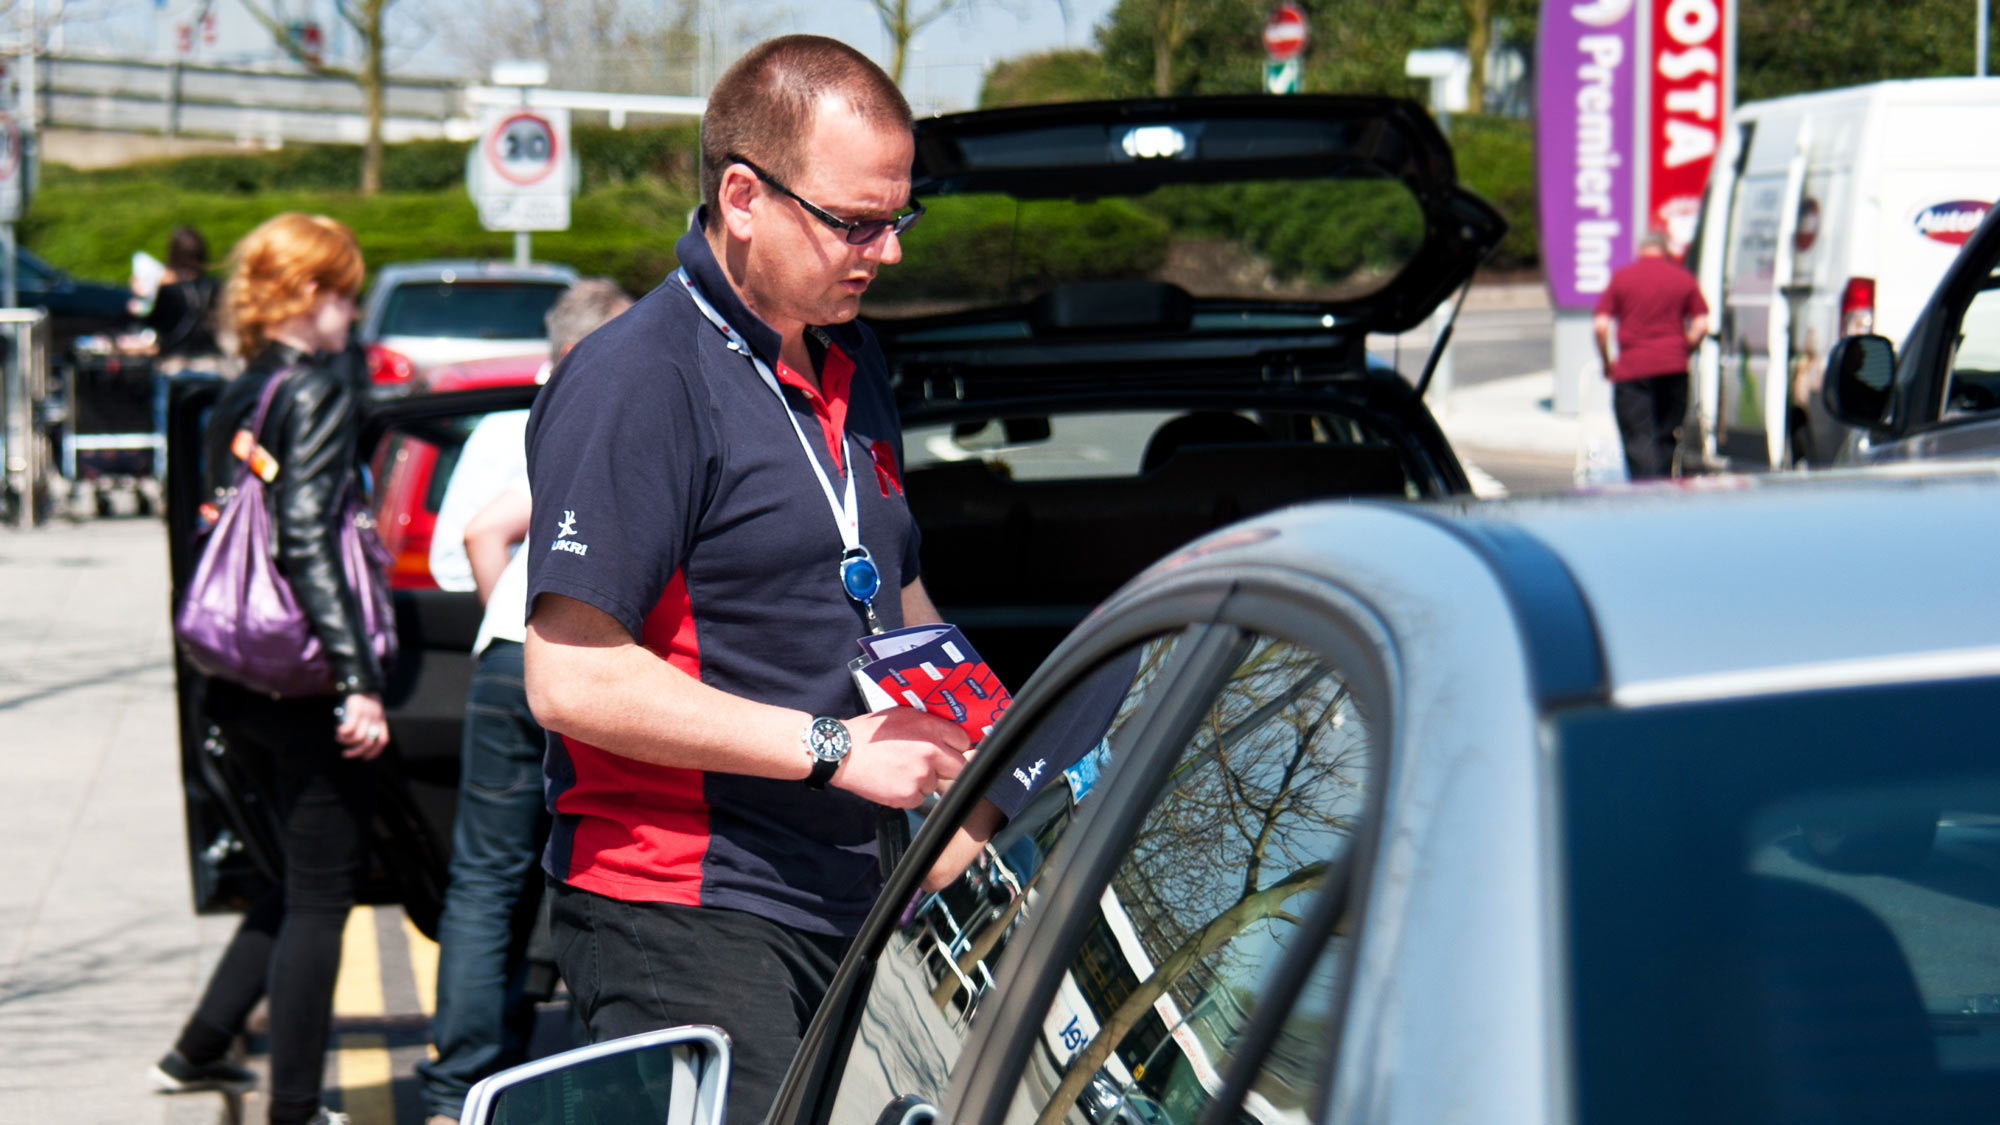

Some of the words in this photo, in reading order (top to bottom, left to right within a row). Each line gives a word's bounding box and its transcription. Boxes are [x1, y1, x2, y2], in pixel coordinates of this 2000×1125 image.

[1576, 35, 1624, 216] Premier
[1658, 0, 1719, 168] OSTA
[1575, 220, 1620, 293] Inn
[551, 540, 588, 556] UKRI
